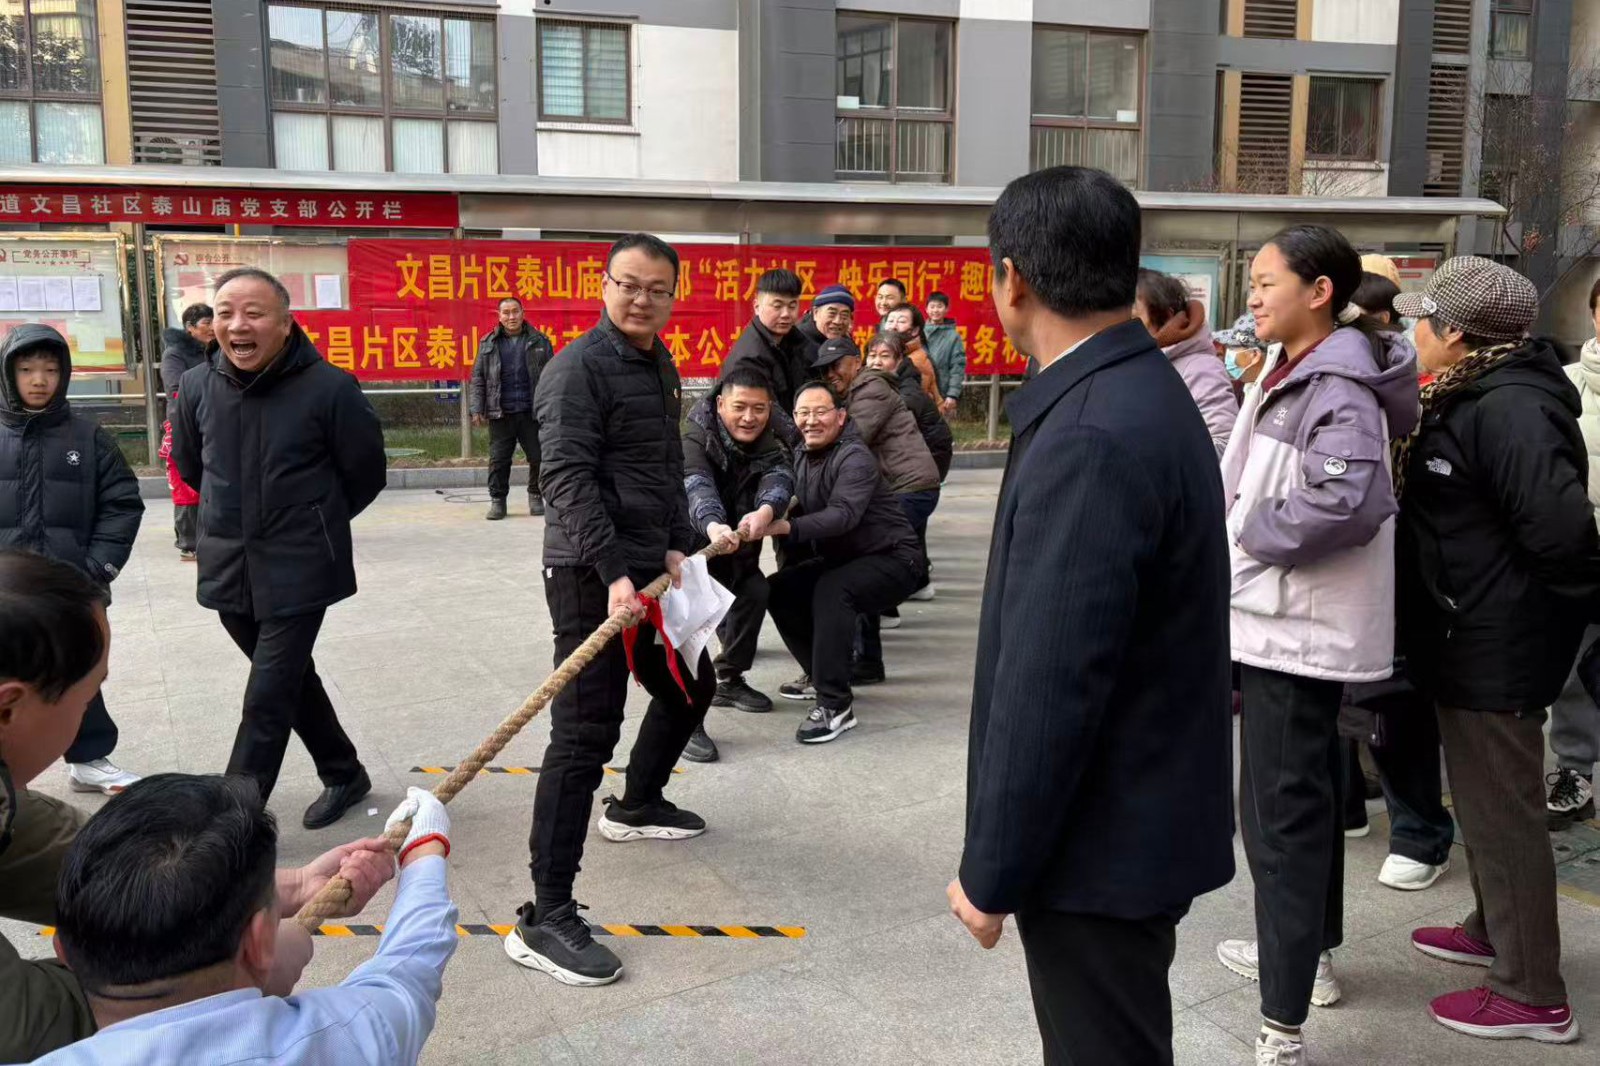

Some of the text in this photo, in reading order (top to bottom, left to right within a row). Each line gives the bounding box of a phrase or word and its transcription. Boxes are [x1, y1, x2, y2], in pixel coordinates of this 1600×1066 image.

[0, 193, 404, 219] 道文昌社区泰山庙党支部公开栏
